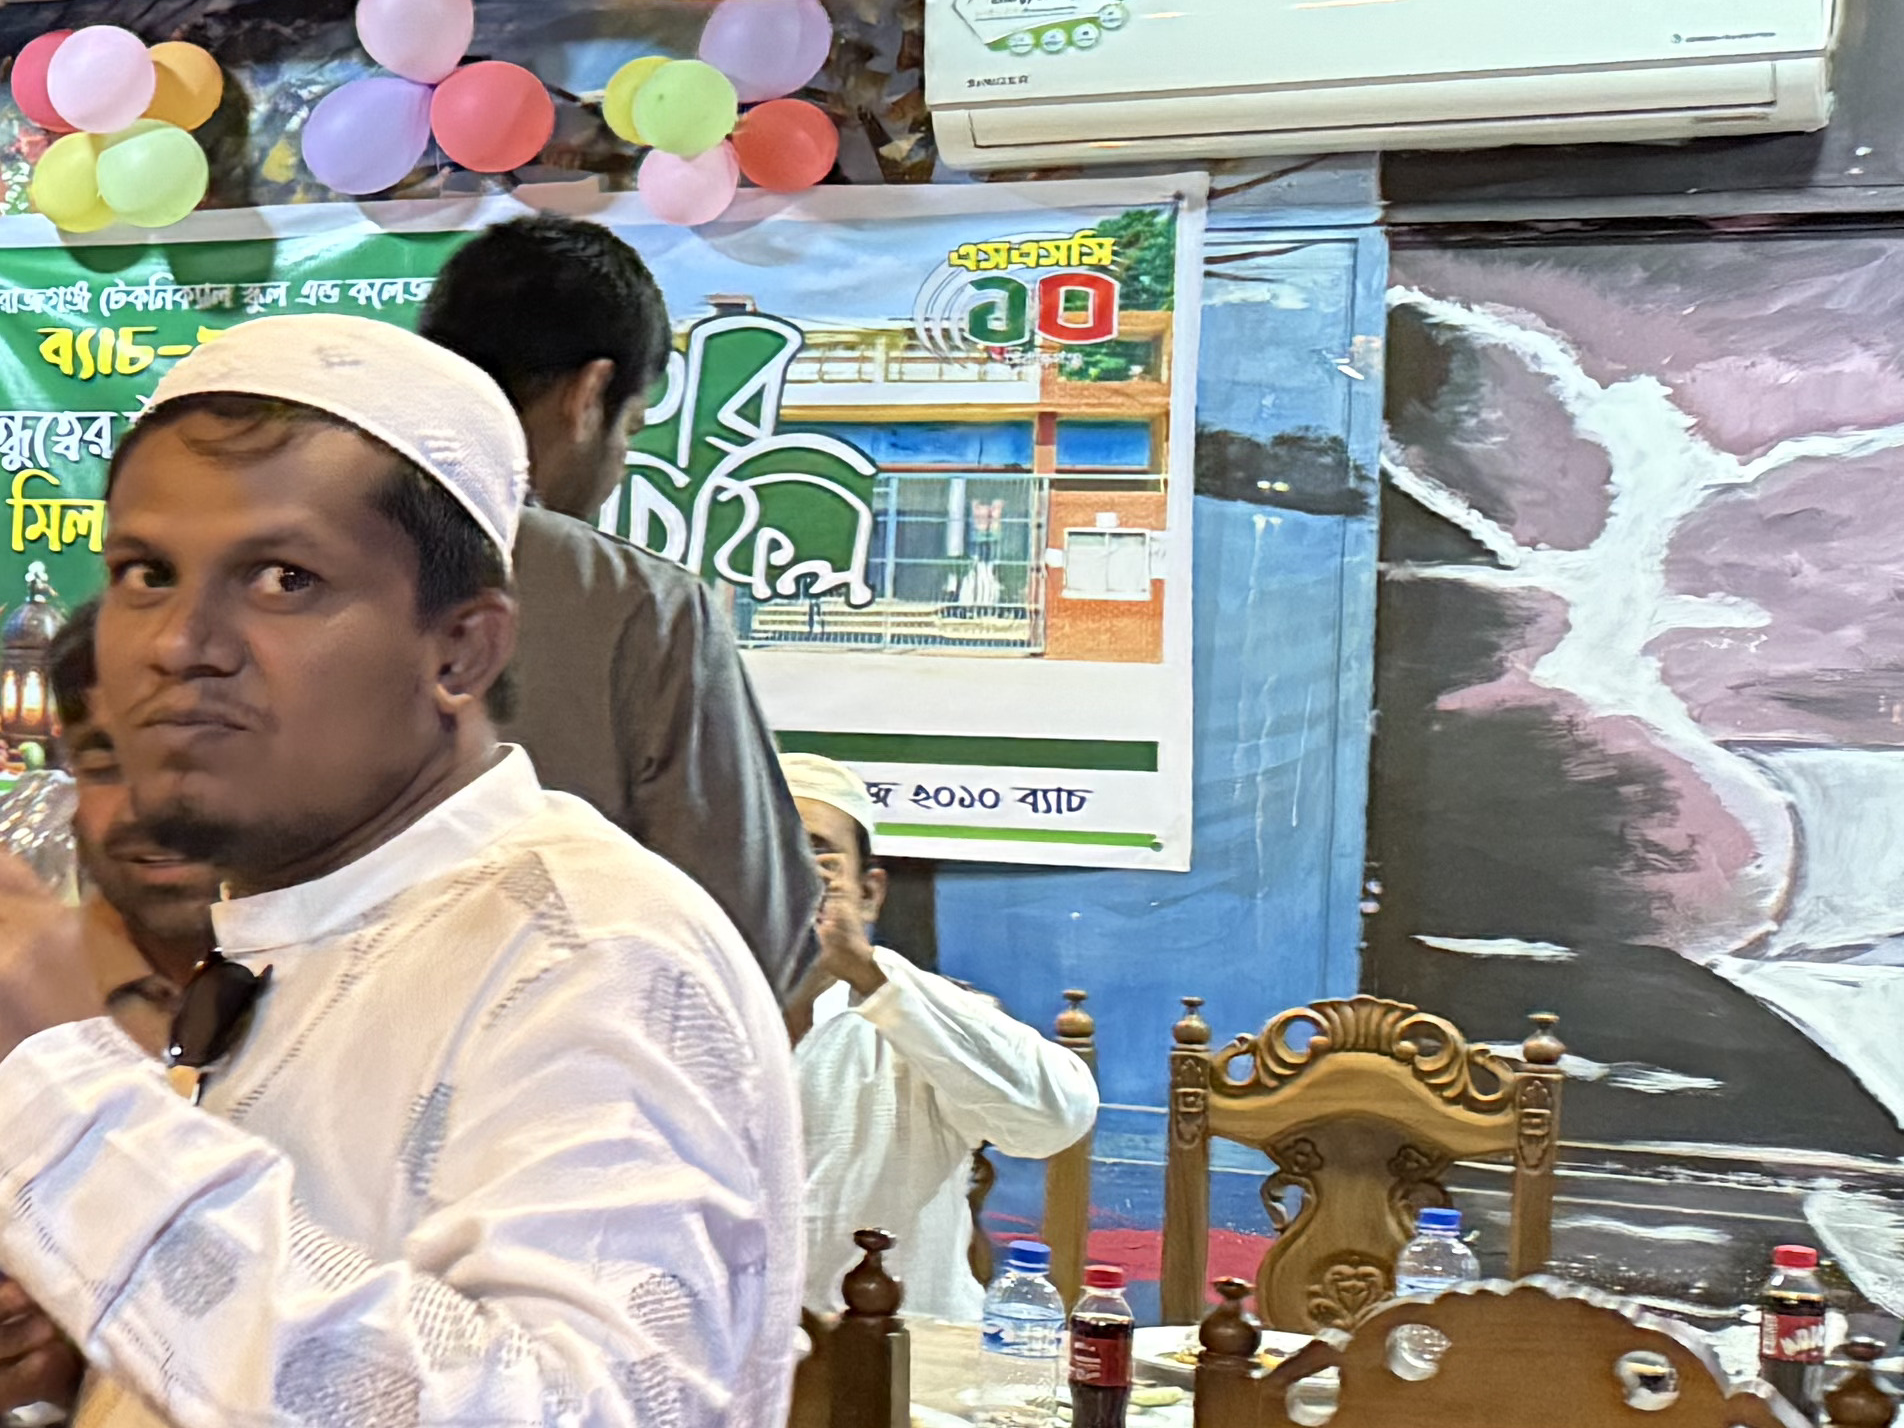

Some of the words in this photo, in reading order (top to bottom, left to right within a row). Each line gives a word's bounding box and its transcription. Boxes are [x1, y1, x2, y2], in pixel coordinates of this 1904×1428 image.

[948, 228, 1117, 271] এসএসসি
[5, 468, 106, 553] মিল
[908, 783, 1001, 810] ২০১০
[1010, 786, 1095, 815] ব্যাচ
